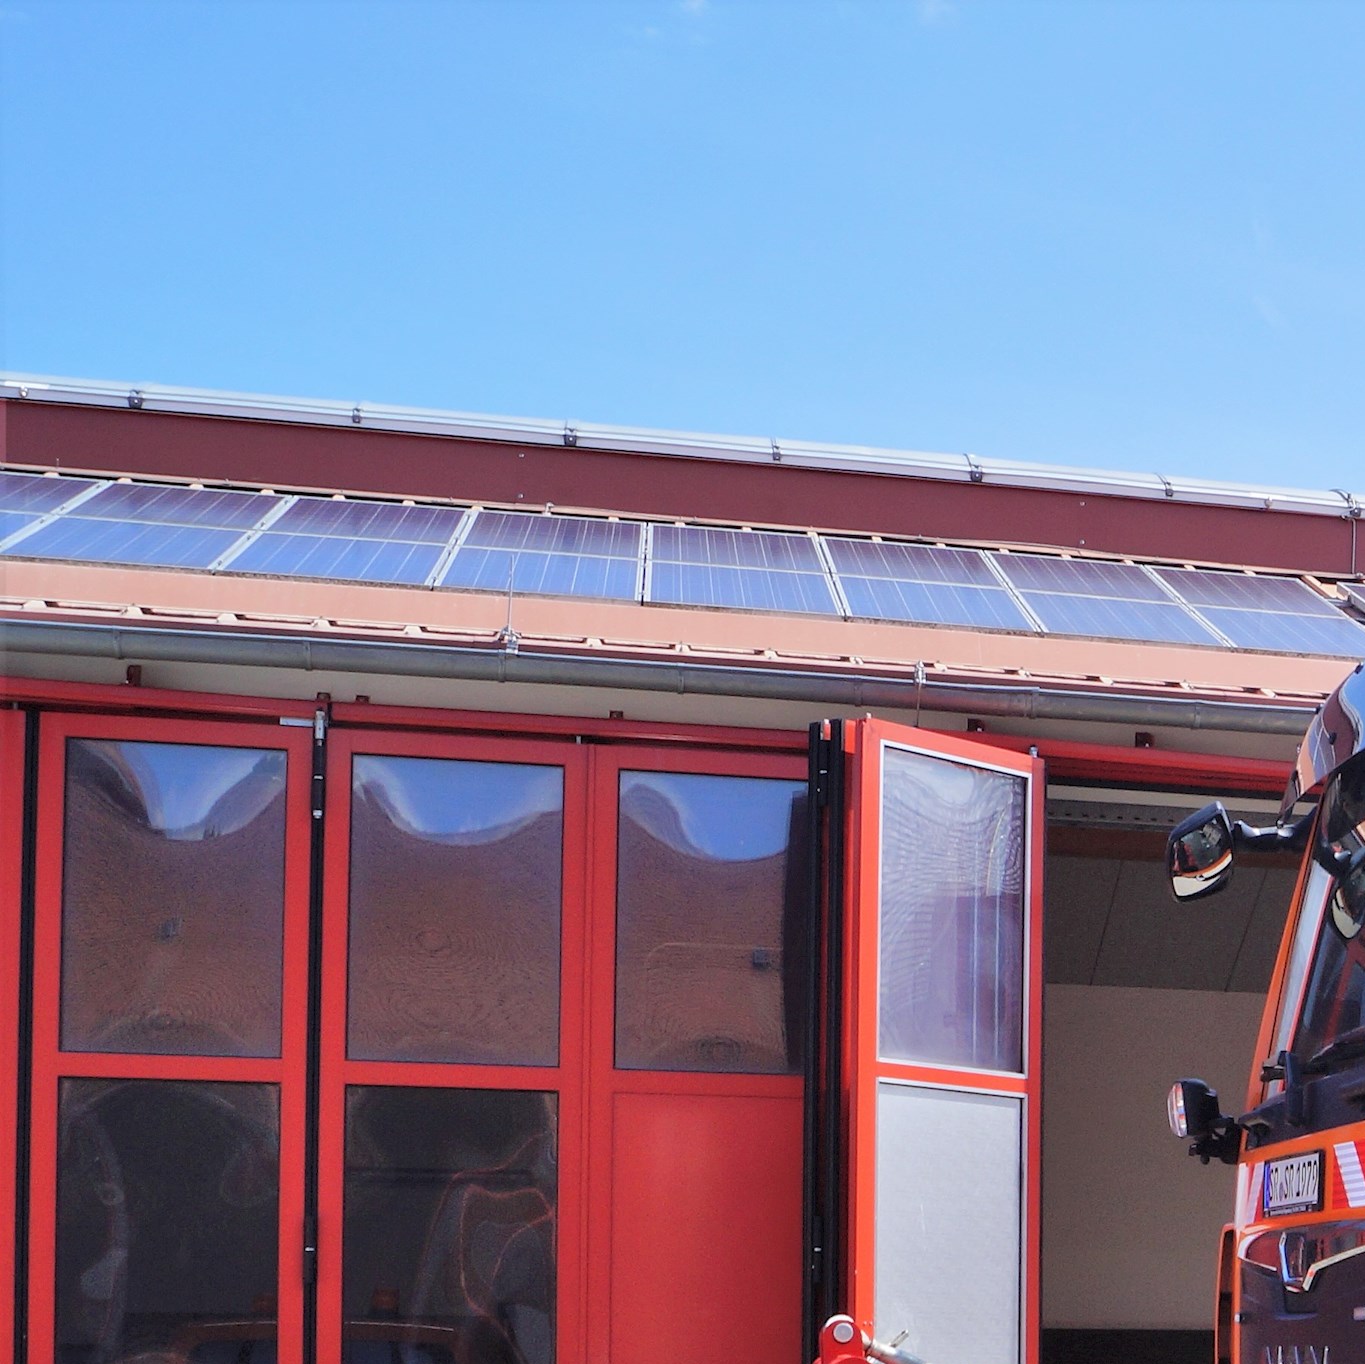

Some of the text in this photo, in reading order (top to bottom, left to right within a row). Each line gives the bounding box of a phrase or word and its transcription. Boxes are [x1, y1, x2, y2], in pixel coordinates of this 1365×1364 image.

[1268, 1160, 1320, 1202] SR SR 1979
